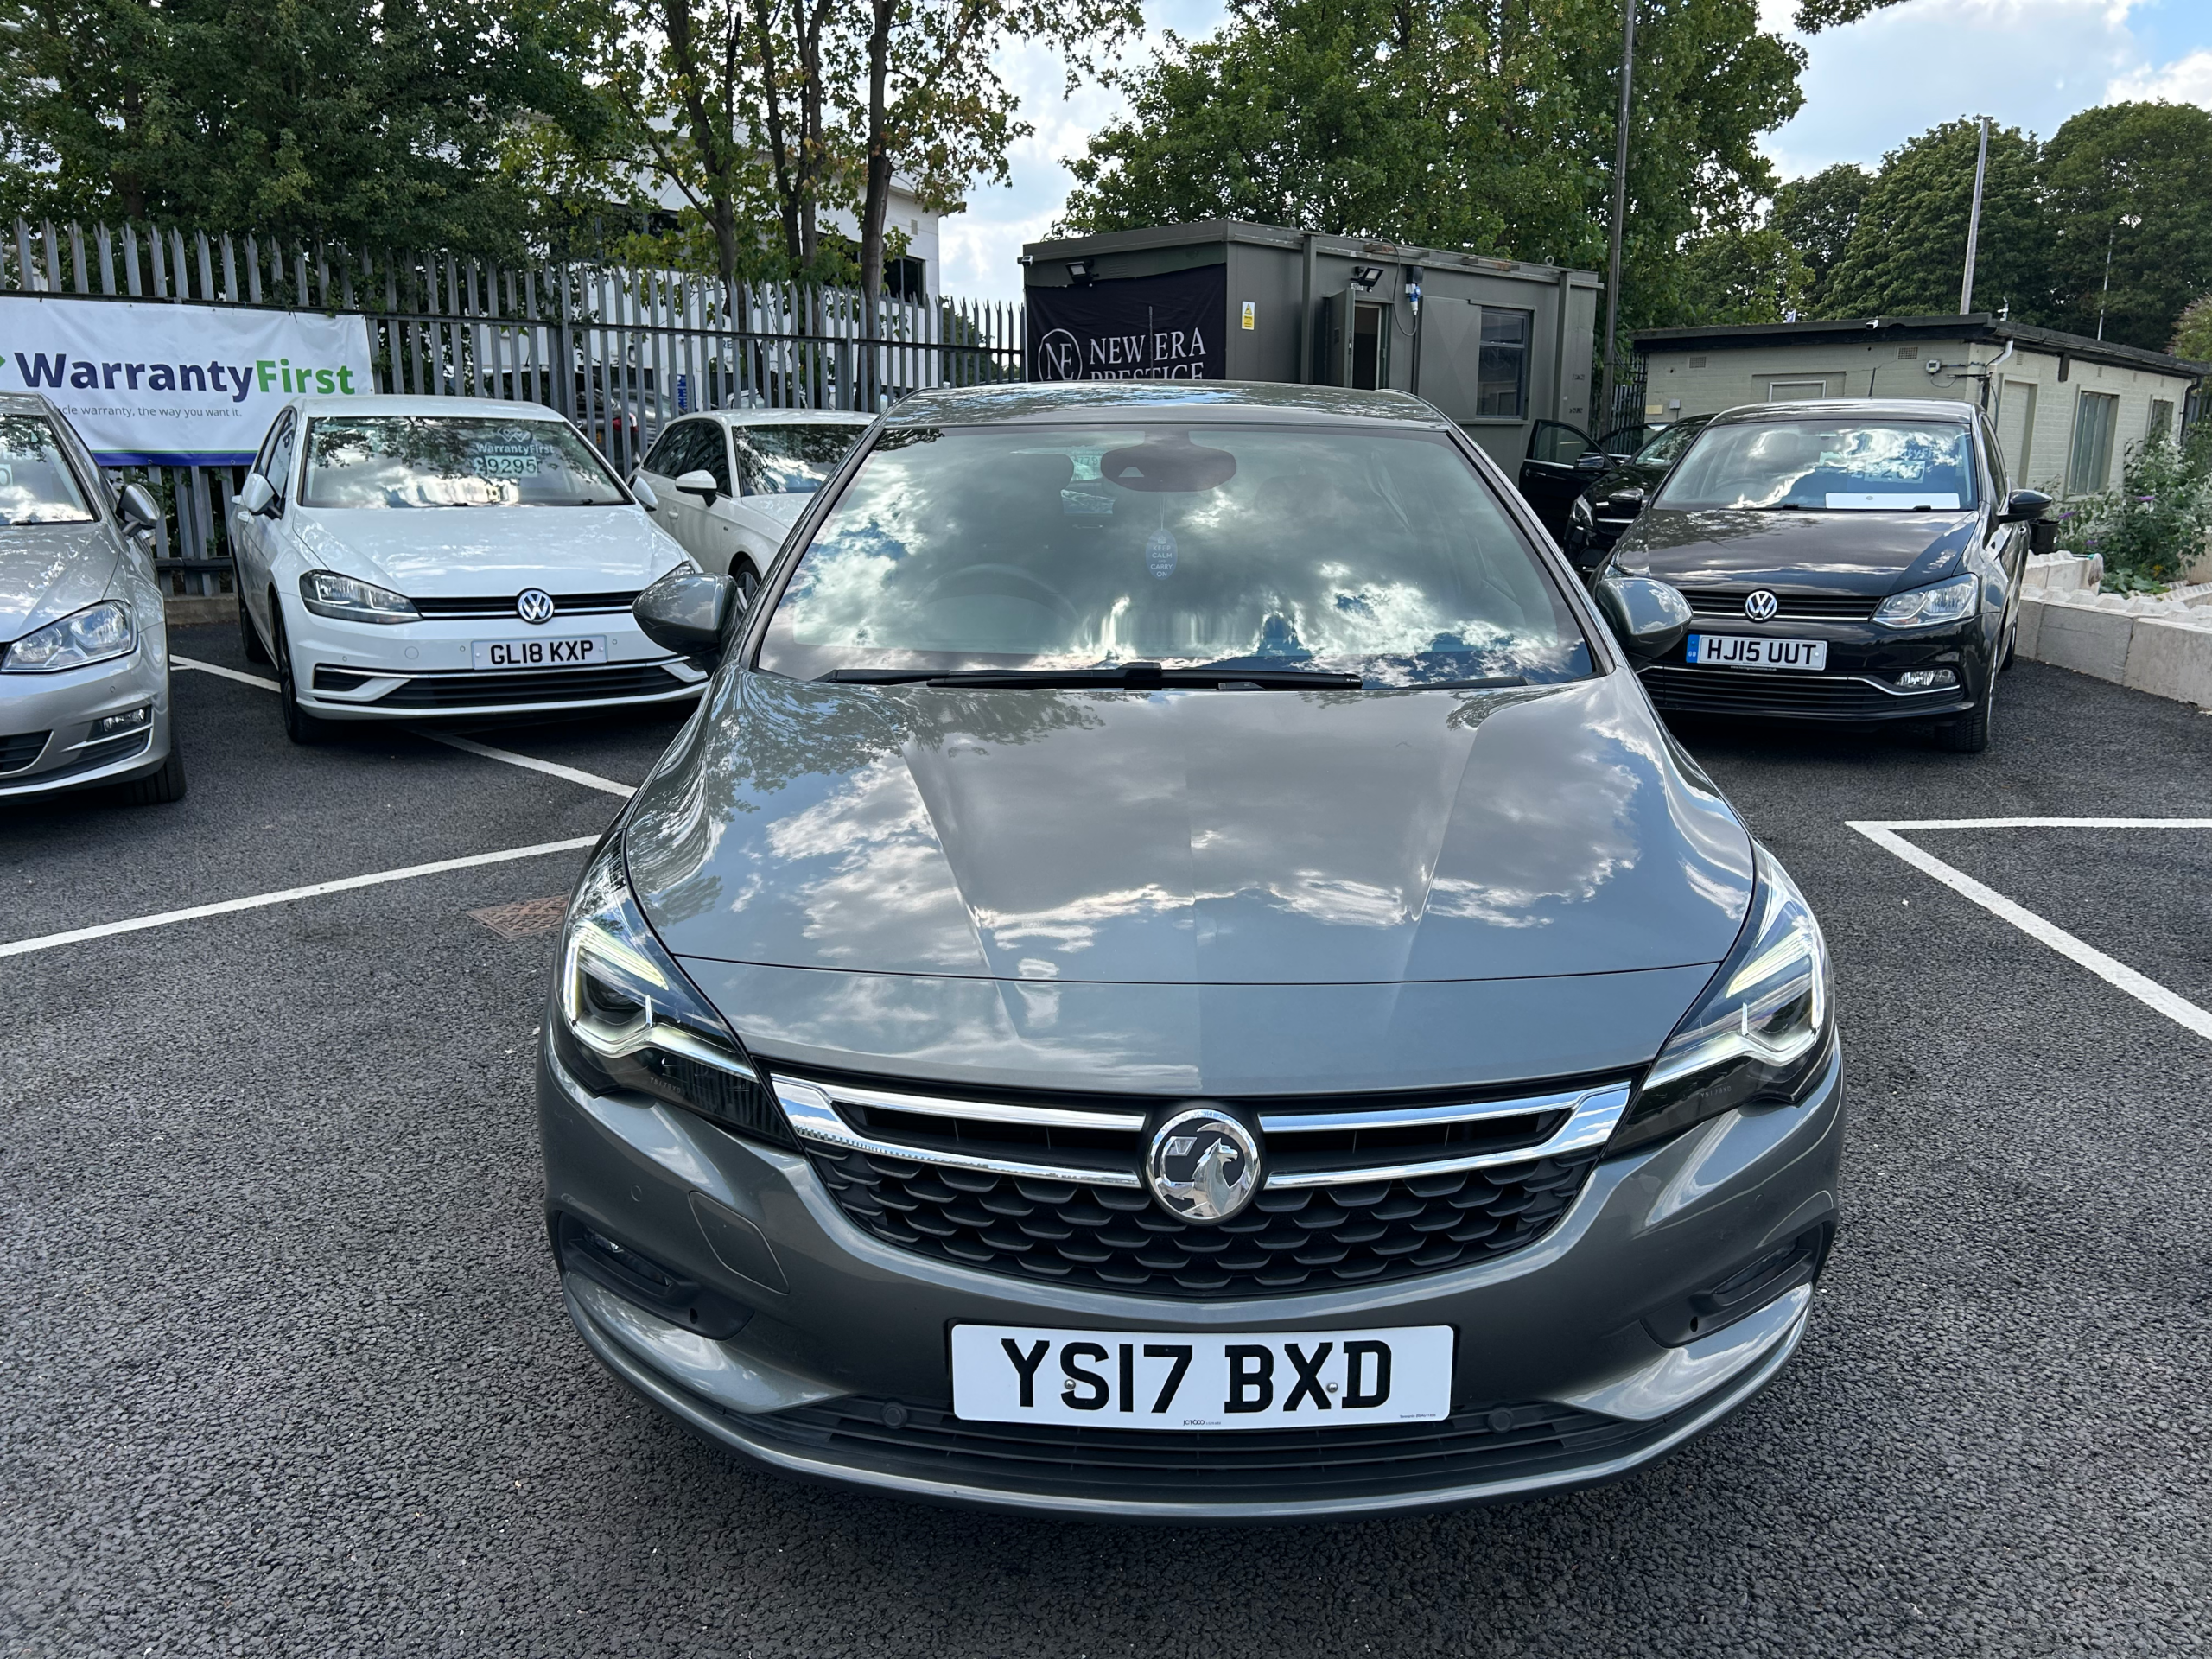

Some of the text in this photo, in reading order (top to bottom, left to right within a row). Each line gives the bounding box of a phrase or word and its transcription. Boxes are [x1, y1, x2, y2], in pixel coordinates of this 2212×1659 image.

[1090, 327, 1207, 365] NEW ERA
[14, 352, 356, 403] WarrantyFirst
[81, 407, 136, 418] warranty,
[138, 405, 156, 416] the
[159, 408, 181, 418] way
[184, 408, 203, 419] you
[205, 407, 230, 417] want
[232, 407, 242, 417] it.
[476, 443, 555, 455] WarrantyFirst
[474, 456, 537, 474] £9295
[490, 639, 594, 665] GL18 KXP
[1707, 639, 1817, 664] HJ15 UUT
[1001, 1338, 1392, 1414] YS17 BXD
